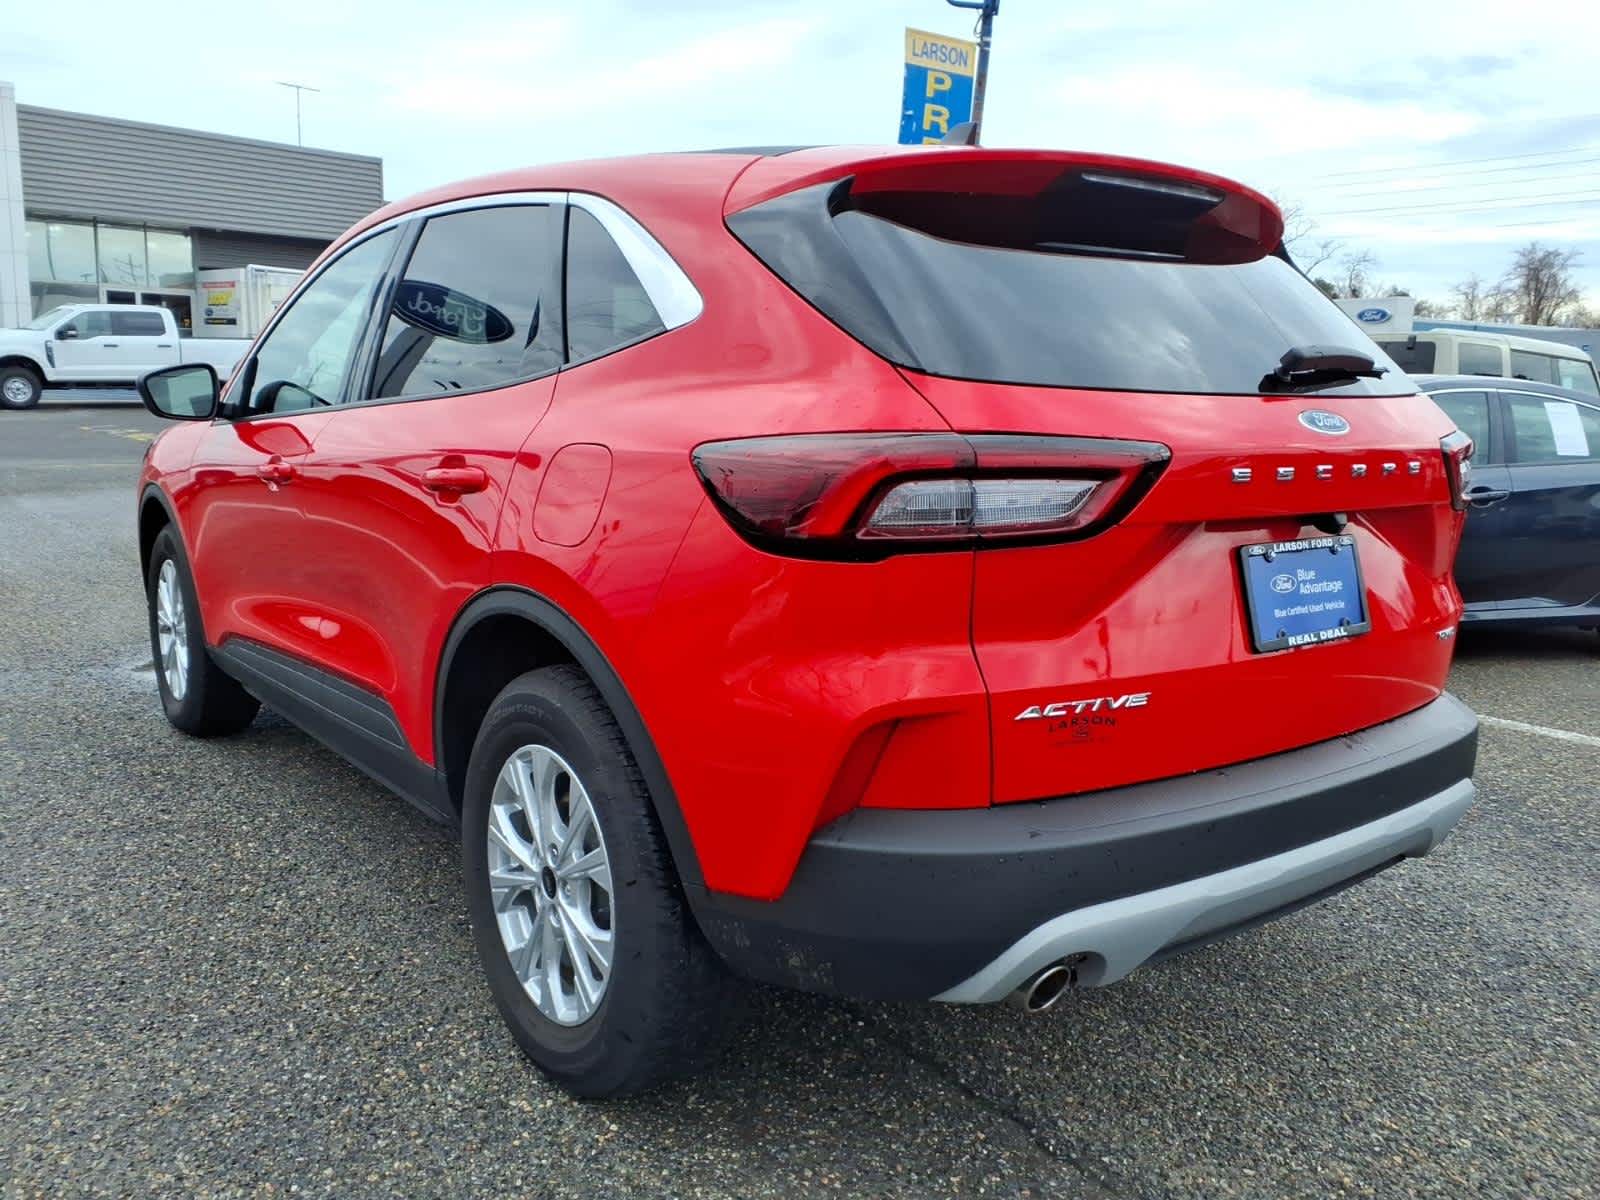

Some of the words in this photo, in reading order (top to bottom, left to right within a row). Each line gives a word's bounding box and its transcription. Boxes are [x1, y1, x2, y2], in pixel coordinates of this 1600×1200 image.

[912, 39, 969, 68] LARSON
[922, 70, 953, 145] PR
[1311, 411, 1345, 428] Ford
[1231, 460, 1421, 484] ESCAPE
[1273, 541, 1310, 553] LARSON
[1311, 538, 1334, 550] FORD
[1296, 568, 1316, 581] Blue
[1299, 579, 1343, 595] Advantage
[1274, 608, 1287, 618] Blue
[1287, 605, 1309, 616] Certified
[1309, 602, 1324, 613] Used
[1288, 634, 1318, 646] REAL
[1319, 627, 1348, 640] DEAL
[1014, 692, 1152, 721] ACTIVE
[1048, 716, 1117, 733] LARSON
